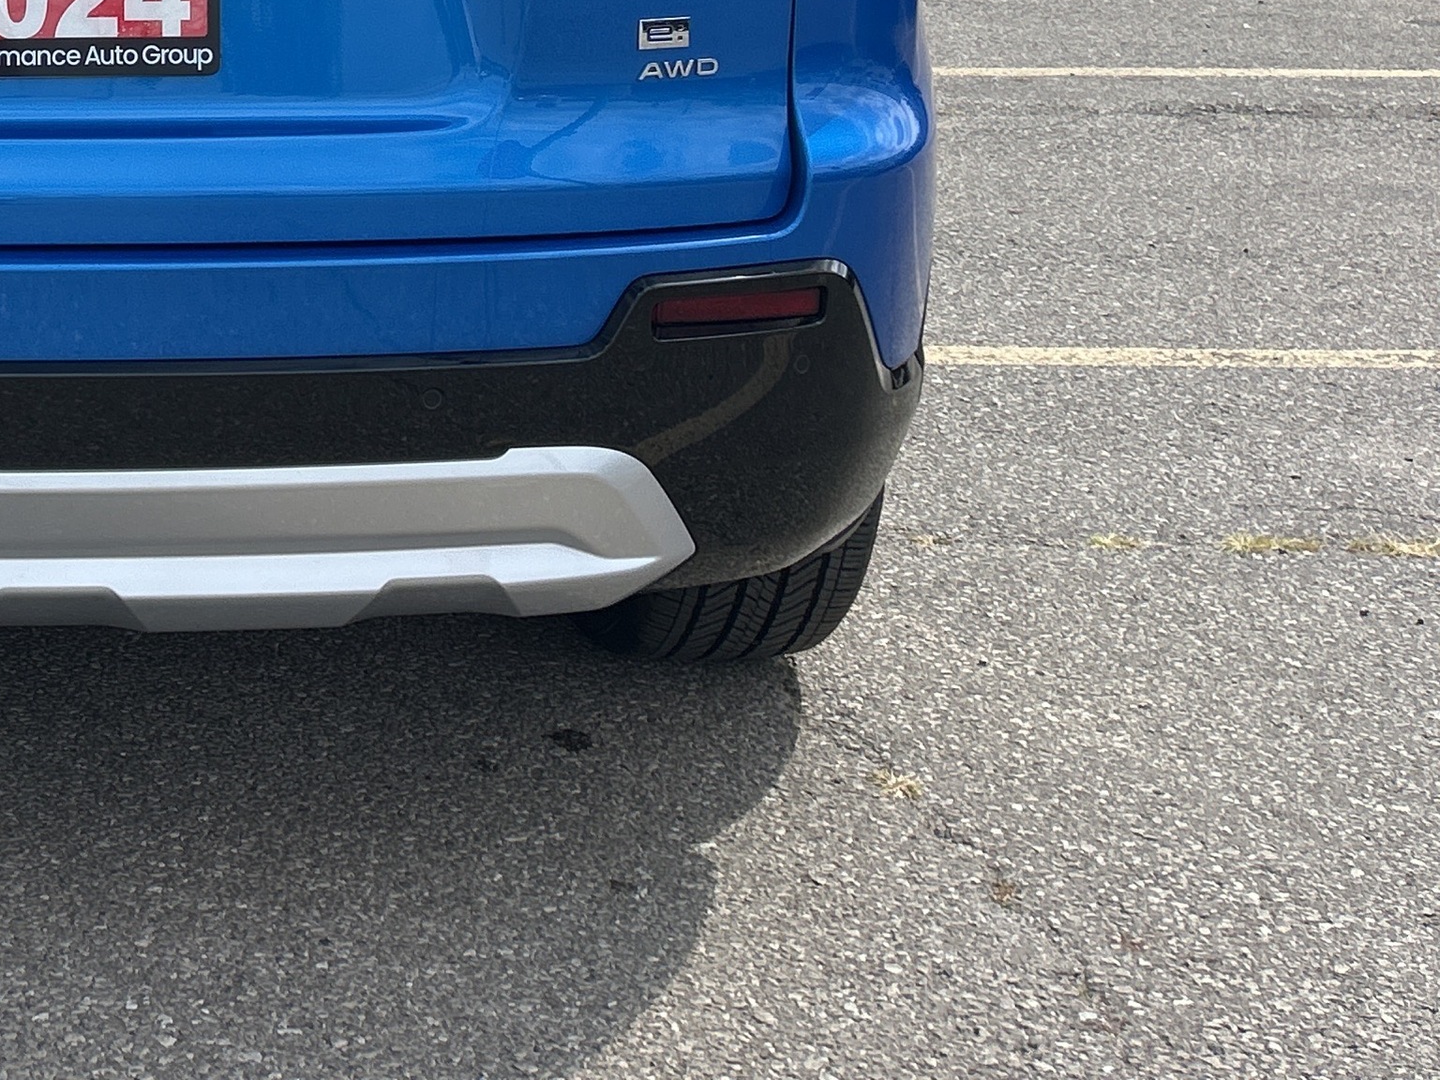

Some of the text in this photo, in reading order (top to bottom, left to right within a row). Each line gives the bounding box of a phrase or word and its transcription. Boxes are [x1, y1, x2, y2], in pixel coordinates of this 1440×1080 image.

[85, 45, 139, 66] Auto
[142, 45, 214, 71] Group
[638, 57, 719, 81] AWD
